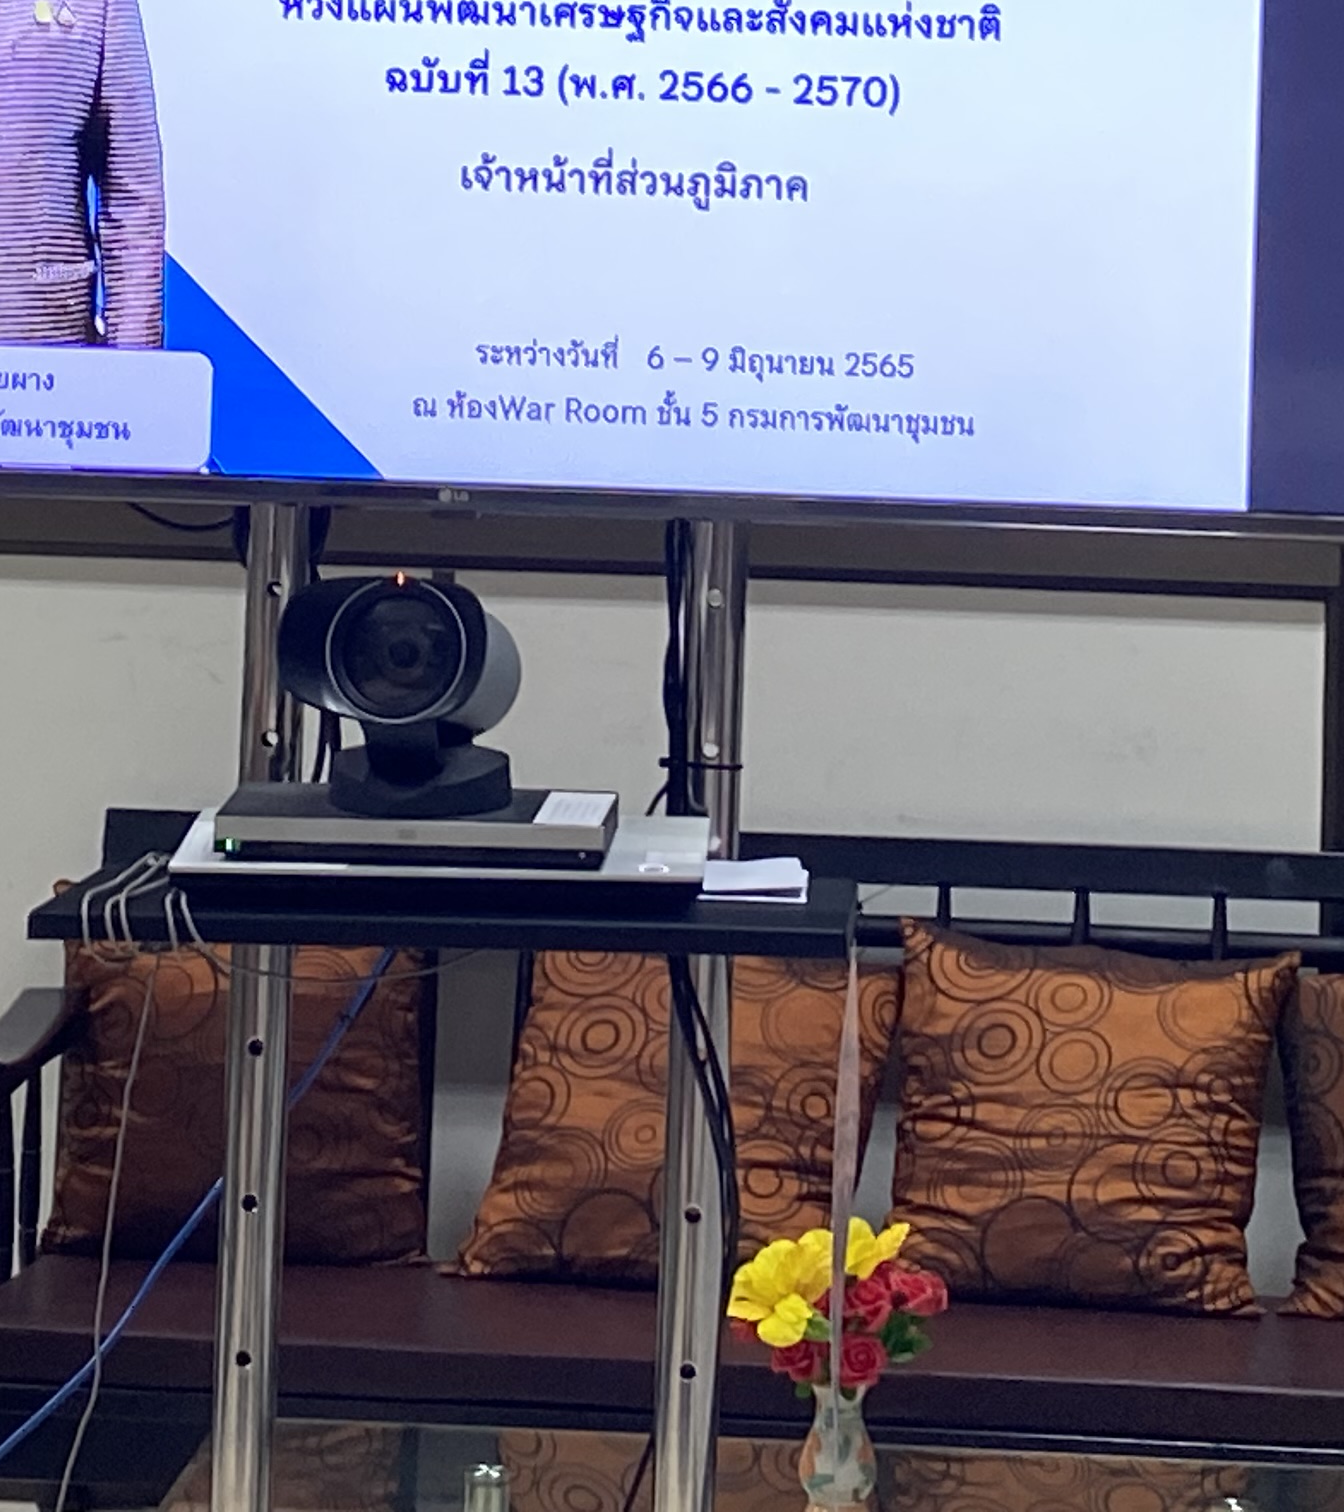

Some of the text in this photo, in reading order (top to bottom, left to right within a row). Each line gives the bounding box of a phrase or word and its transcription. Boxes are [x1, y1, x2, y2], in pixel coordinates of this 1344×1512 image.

[385, 48, 490, 96] ฉบับที่
[502, 65, 544, 98] 13
[558, 64, 645, 106] (พ.ศ.
[659, 69, 753, 104] 2566
[792, 73, 900, 116] 2570)
[461, 146, 808, 212] เจ้าหน้าที่ส่วนภูมิภาค
[647, 345, 665, 370] 6
[701, 346, 720, 372] 9
[728, 345, 835, 383] มิถุนายน
[844, 352, 915, 379] 2565
[412, 397, 437, 418] ณ
[565, 397, 647, 425] Room
[656, 389, 692, 427] ชั้น
[701, 401, 719, 428] 5
[728, 403, 975, 444] กรมการพัฒนาชุมชน
